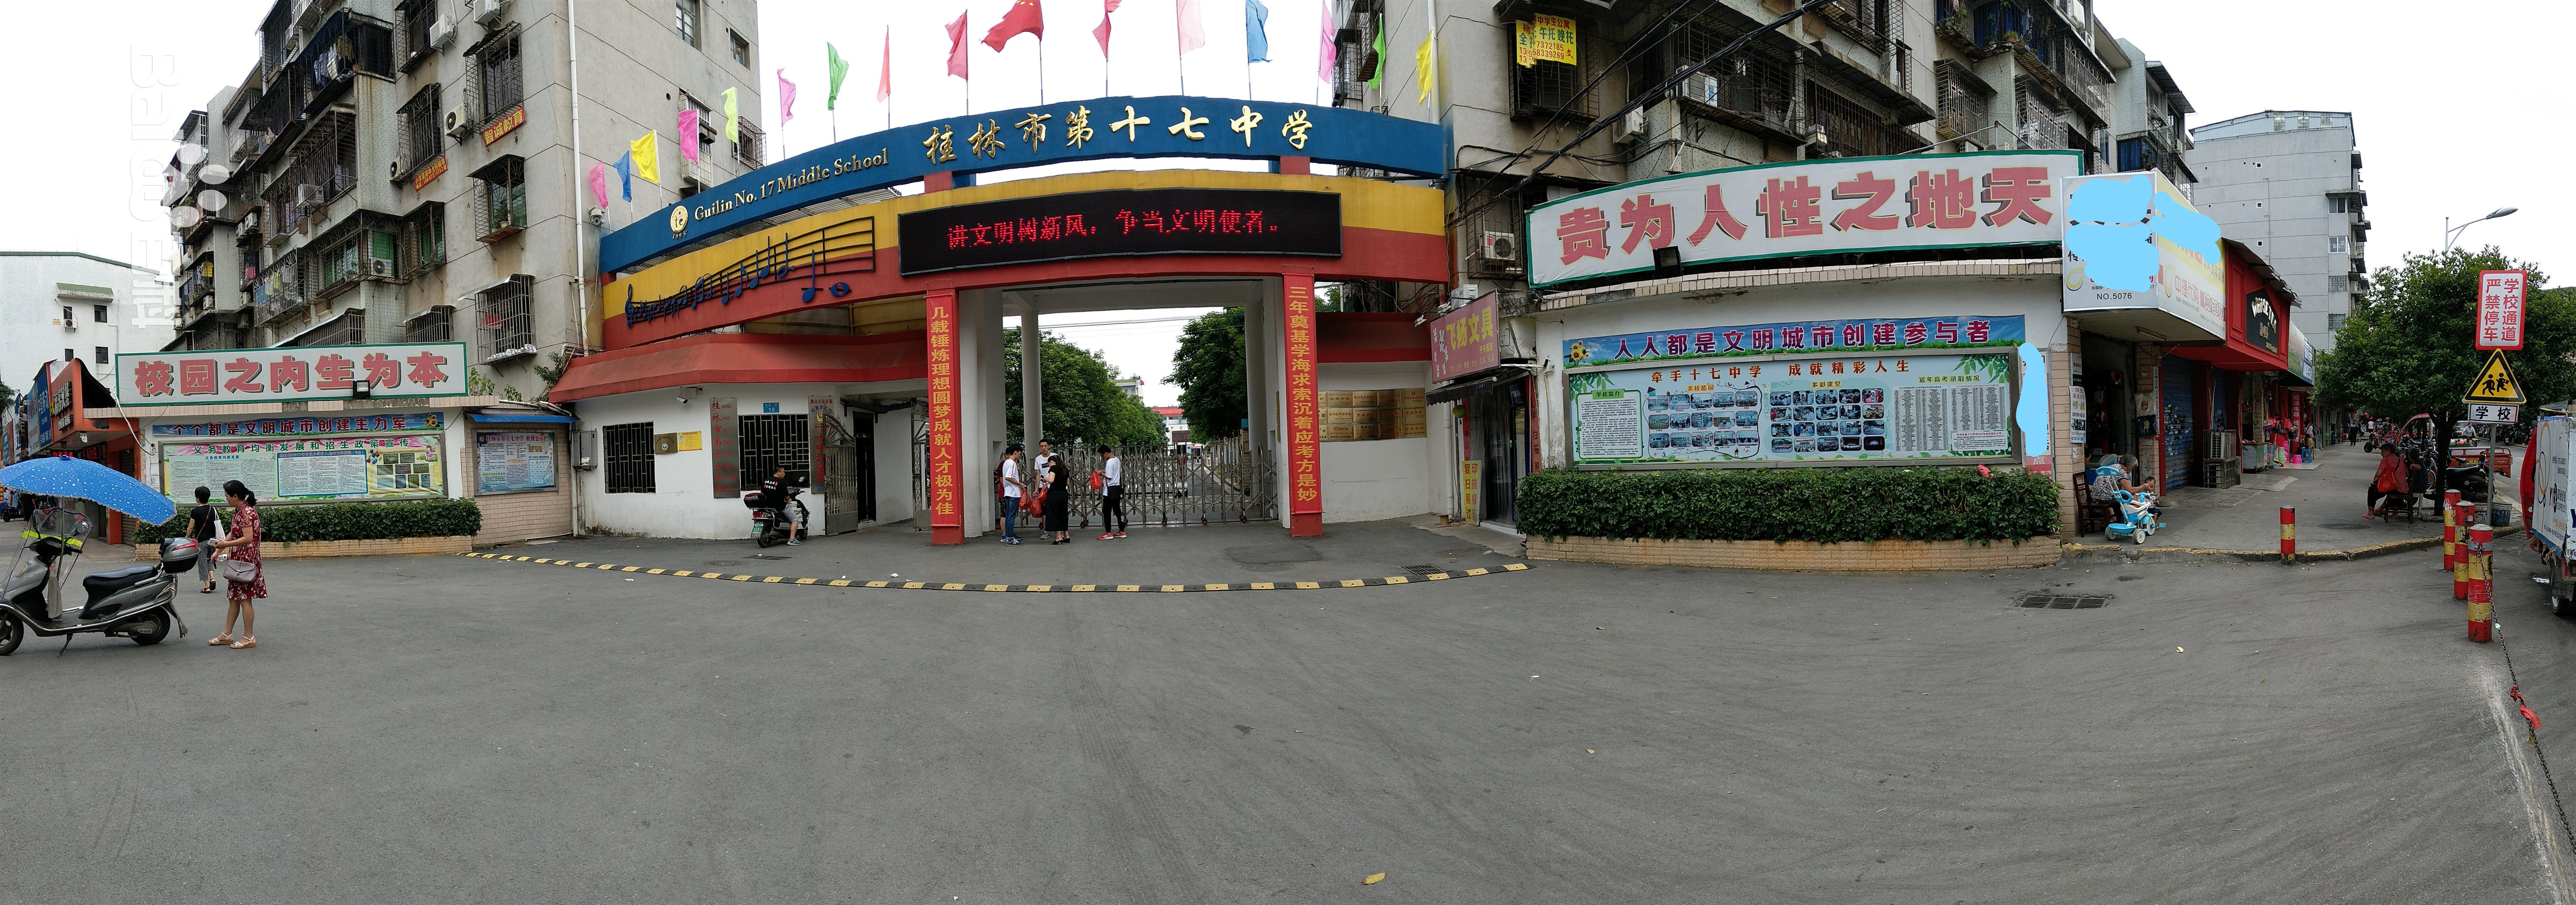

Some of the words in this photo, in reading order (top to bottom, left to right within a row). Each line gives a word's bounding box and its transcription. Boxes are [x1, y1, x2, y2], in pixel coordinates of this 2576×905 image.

[1539, 26, 1555, 40] 午托
[1557, 29, 1574, 45] 晚托
[484, 109, 523, 145] 智诚教育
[923, 104, 1313, 165] 桂林市第十七中学
[415, 157, 445, 184] 小学至高中全科辅导
[695, 199, 733, 221] Guilin
[735, 190, 758, 206] No.
[760, 180, 775, 199] 17
[777, 164, 829, 194] Middle
[834, 148, 888, 176] School
[2175, 275, 2199, 304] 中捷代购
[1446, 306, 1494, 350] 飞扬文具
[2483, 278, 2501, 342] 严禁停车
[2501, 278, 2520, 342] 学校通道
[1613, 319, 1992, 361] 人人都是文明城市创建参与者
[134, 351, 448, 397] 校园之内生为本
[1650, 364, 1762, 384] 牵手十七中学
[1788, 359, 1910, 376] 成就精彩人生
[1919, 375, 1980, 383] 近年高考录取情况
[930, 306, 955, 515] 几载锤炼理想圆梦成就人才极为佳
[1288, 286, 1318, 502] 三年奠基学海求索沉着应考方是妙
[2475, 405, 2511, 422] 学校
[172, 416, 407, 436] 个个都是文明城市创建主力军
[1532, 431, 1539, 454] 扫描
[193, 438, 409, 455] 义务教育均衡发展和招生政策宣传
[711, 400, 724, 495] 桂林市第十七中学
